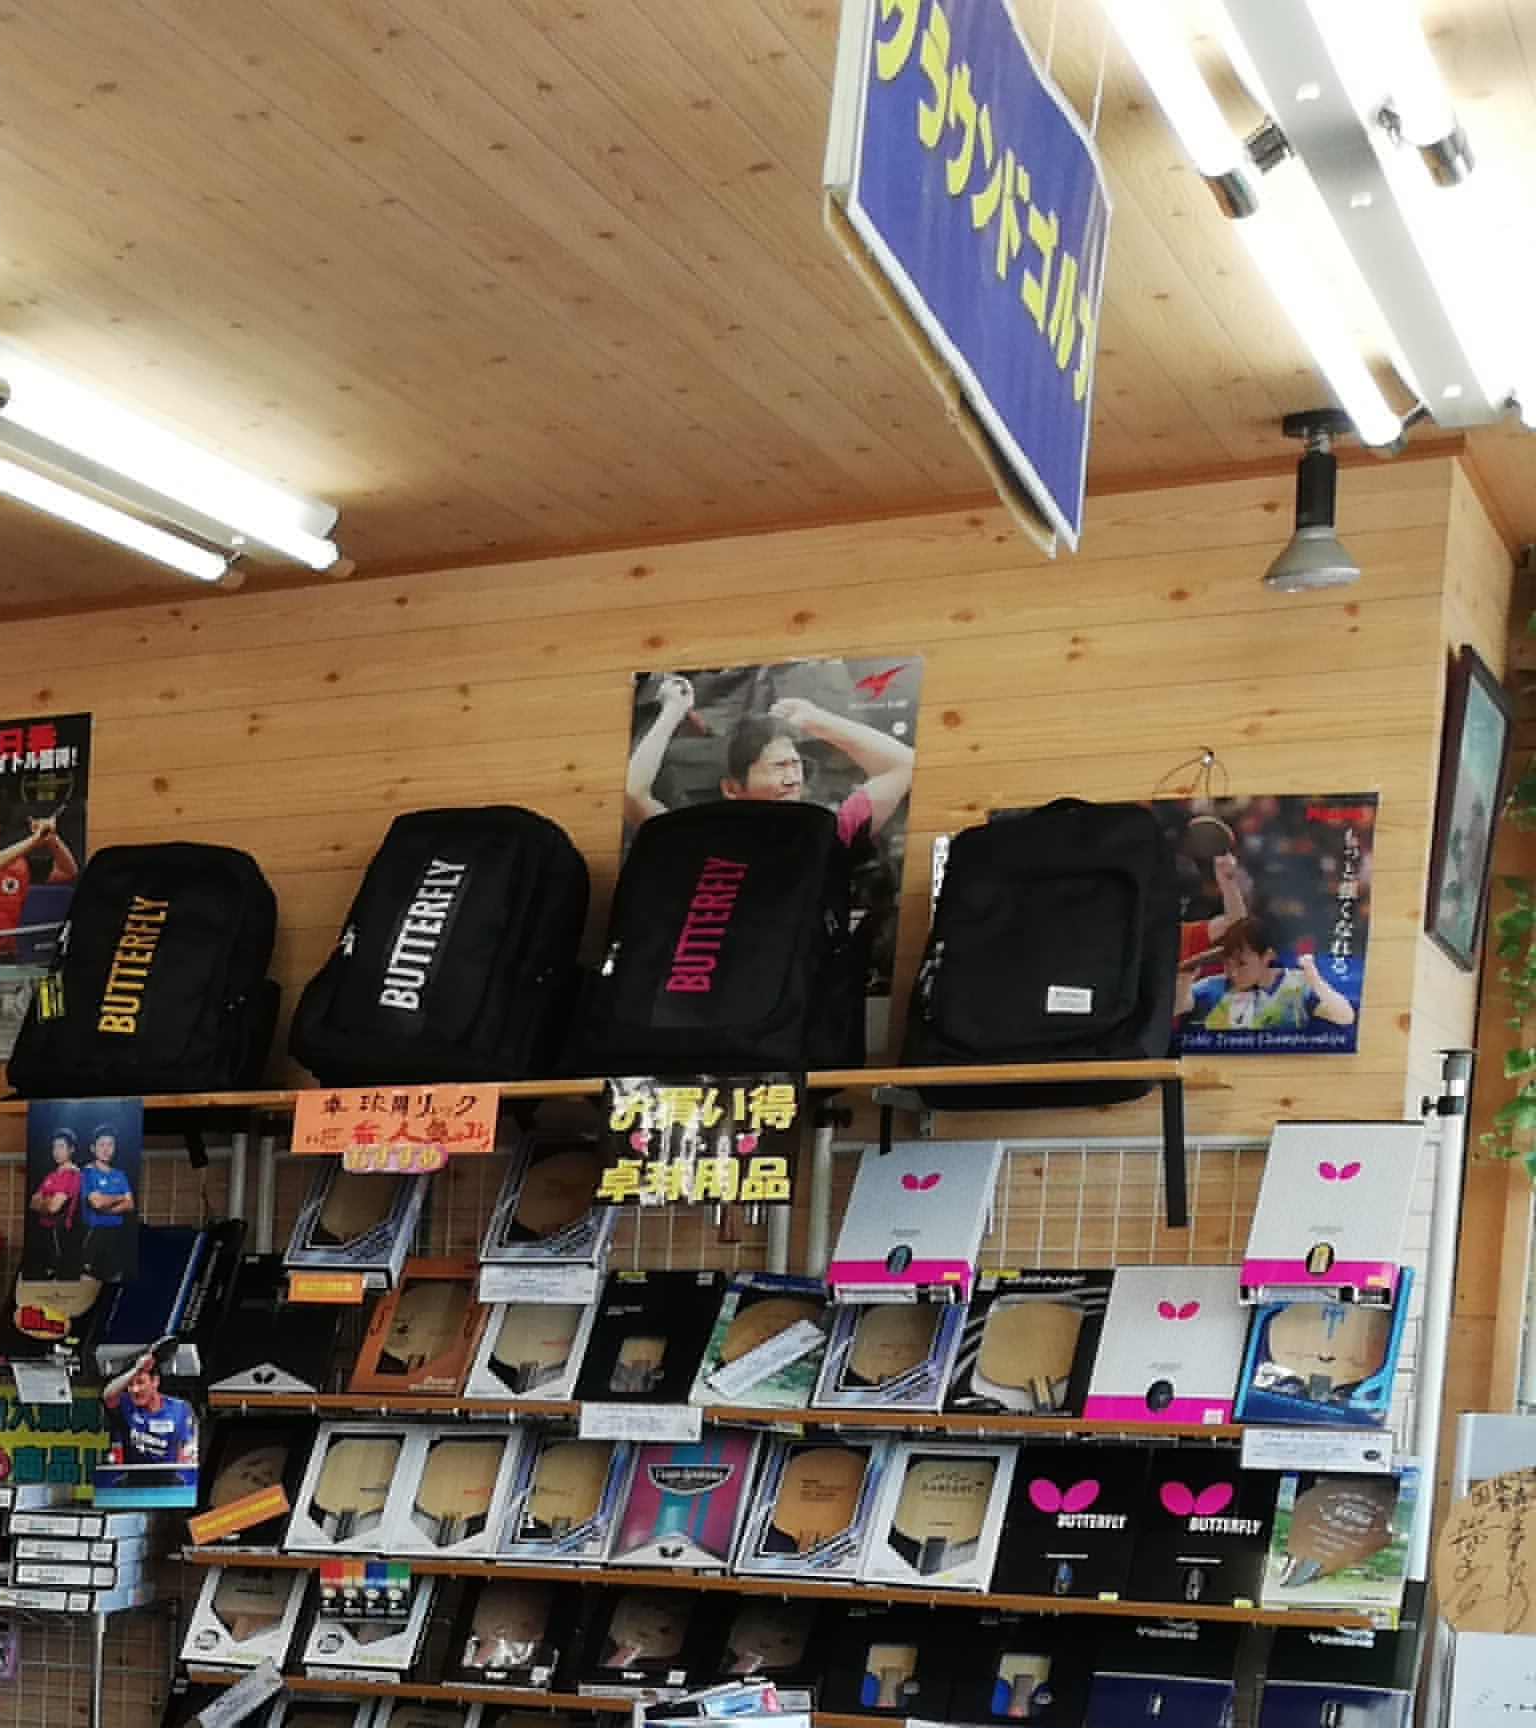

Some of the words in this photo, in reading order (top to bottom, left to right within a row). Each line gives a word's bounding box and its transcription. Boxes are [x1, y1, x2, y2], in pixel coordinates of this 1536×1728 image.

[380, 856, 468, 1012] BUTTERFLY
[666, 856, 749, 996] BUTTERFLY
[98, 896, 169, 1035] BUTTERFLY
[609, 1084, 798, 1132] お買い得
[596, 1157, 791, 1202] 卓球用品
[1057, 1513, 1128, 1531] BUTTERFLY
[1188, 1518, 1263, 1536] BUTTERFLY
